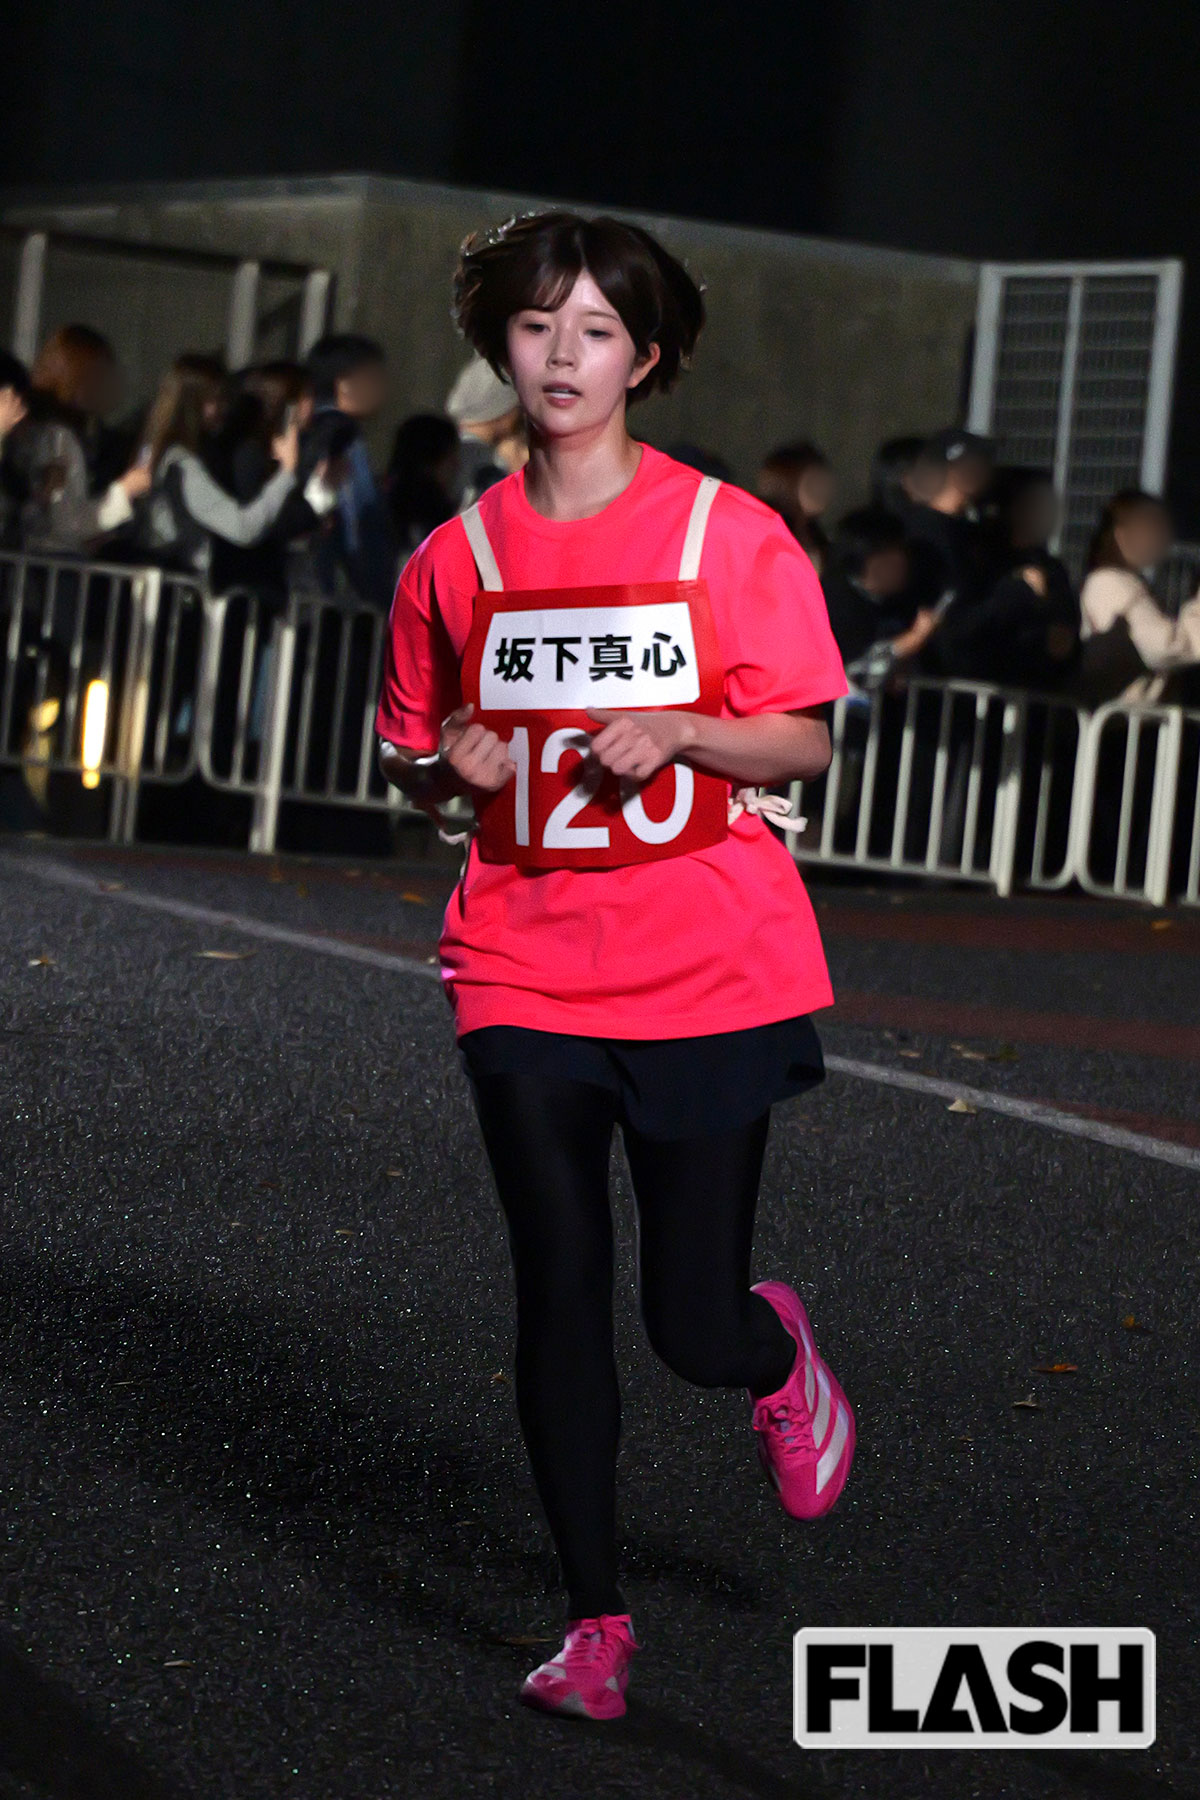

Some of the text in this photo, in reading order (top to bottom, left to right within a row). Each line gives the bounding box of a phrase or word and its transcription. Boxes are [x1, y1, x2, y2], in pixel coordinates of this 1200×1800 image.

[493, 631, 687, 682] 坂下真心
[508, 726, 694, 849] 120
